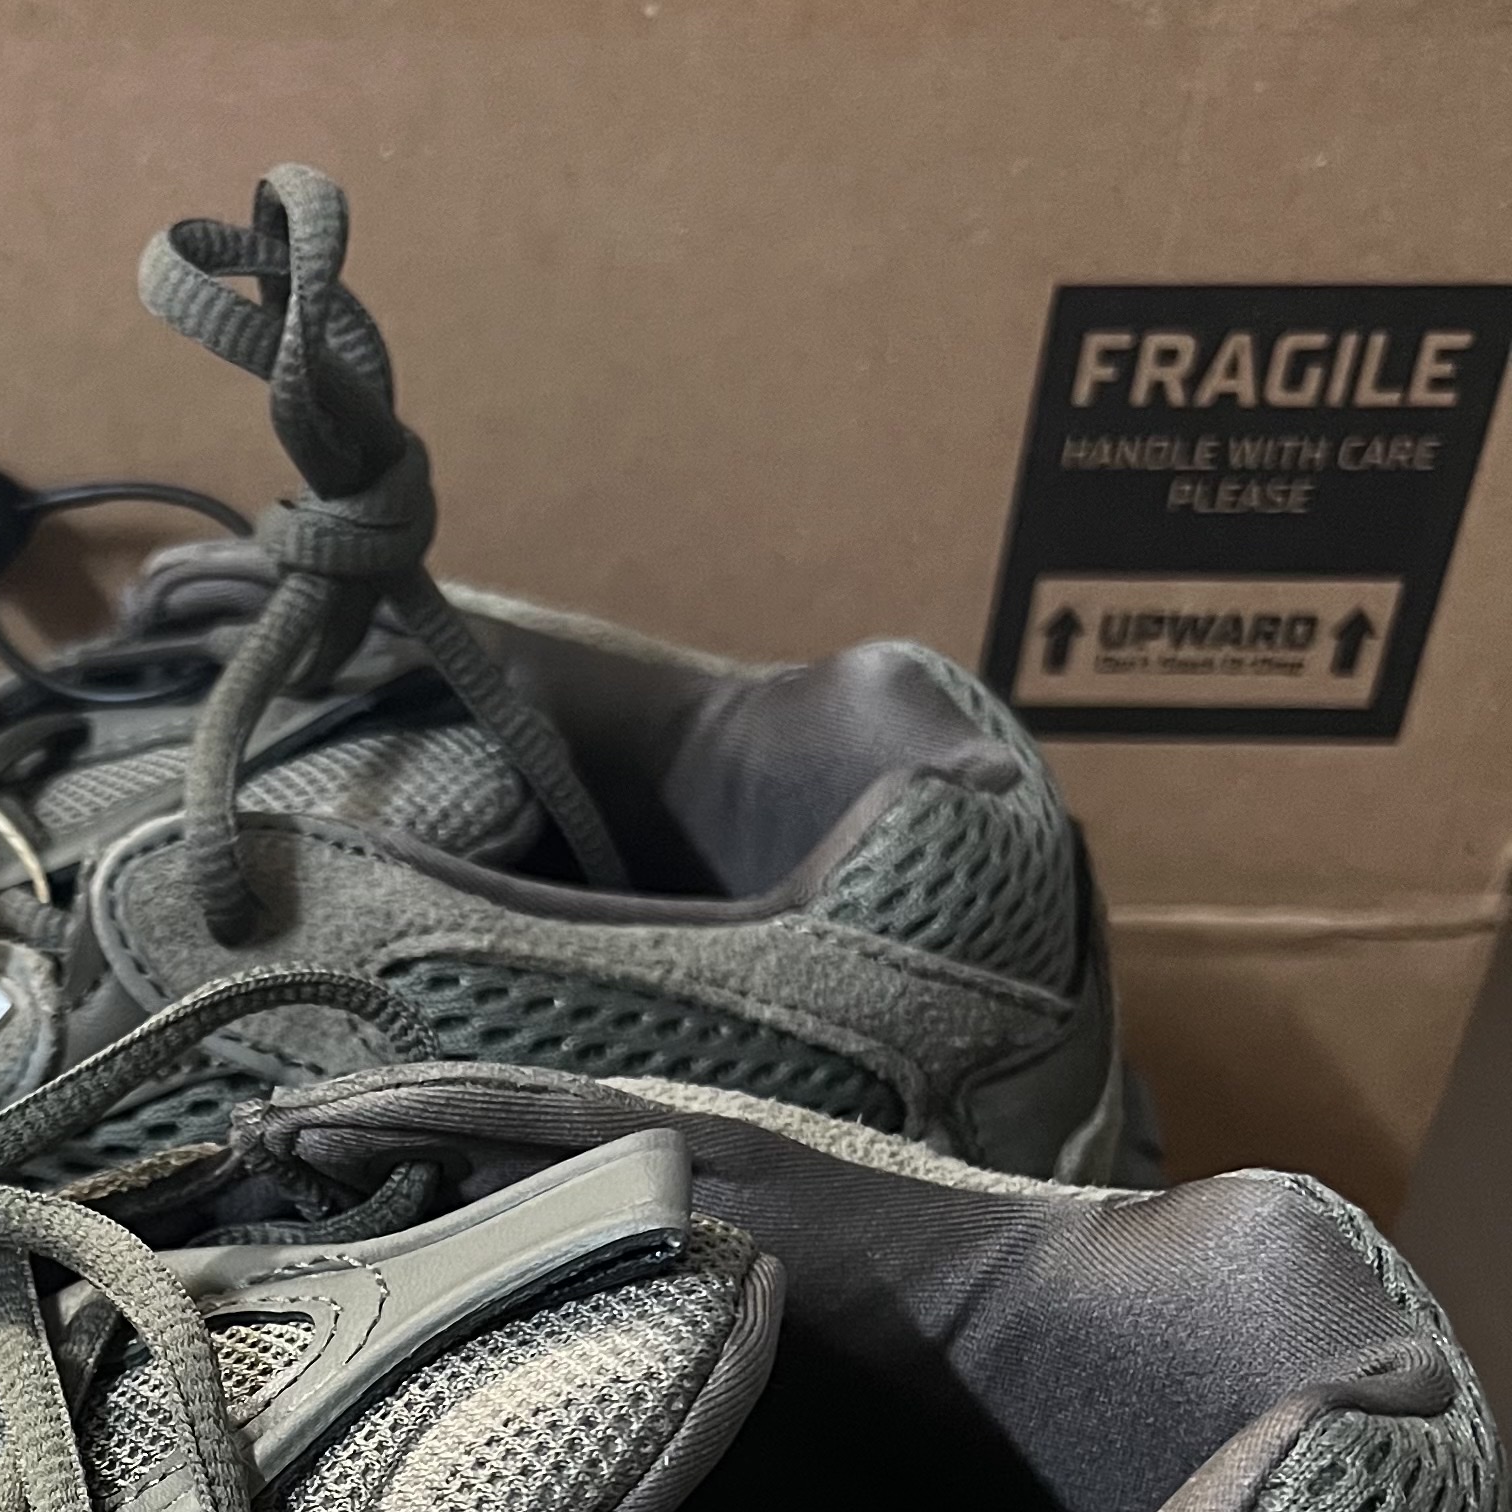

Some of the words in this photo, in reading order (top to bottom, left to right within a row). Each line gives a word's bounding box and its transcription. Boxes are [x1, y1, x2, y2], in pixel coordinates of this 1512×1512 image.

[1070, 328, 1475, 409] FRAGILE
[1060, 435, 1220, 471] HANDLE
[1227, 434, 1330, 471] WITH
[1337, 435, 1442, 471] CARE
[1167, 477, 1317, 514] PLEASE
[1098, 613, 1319, 650] UPWARD
